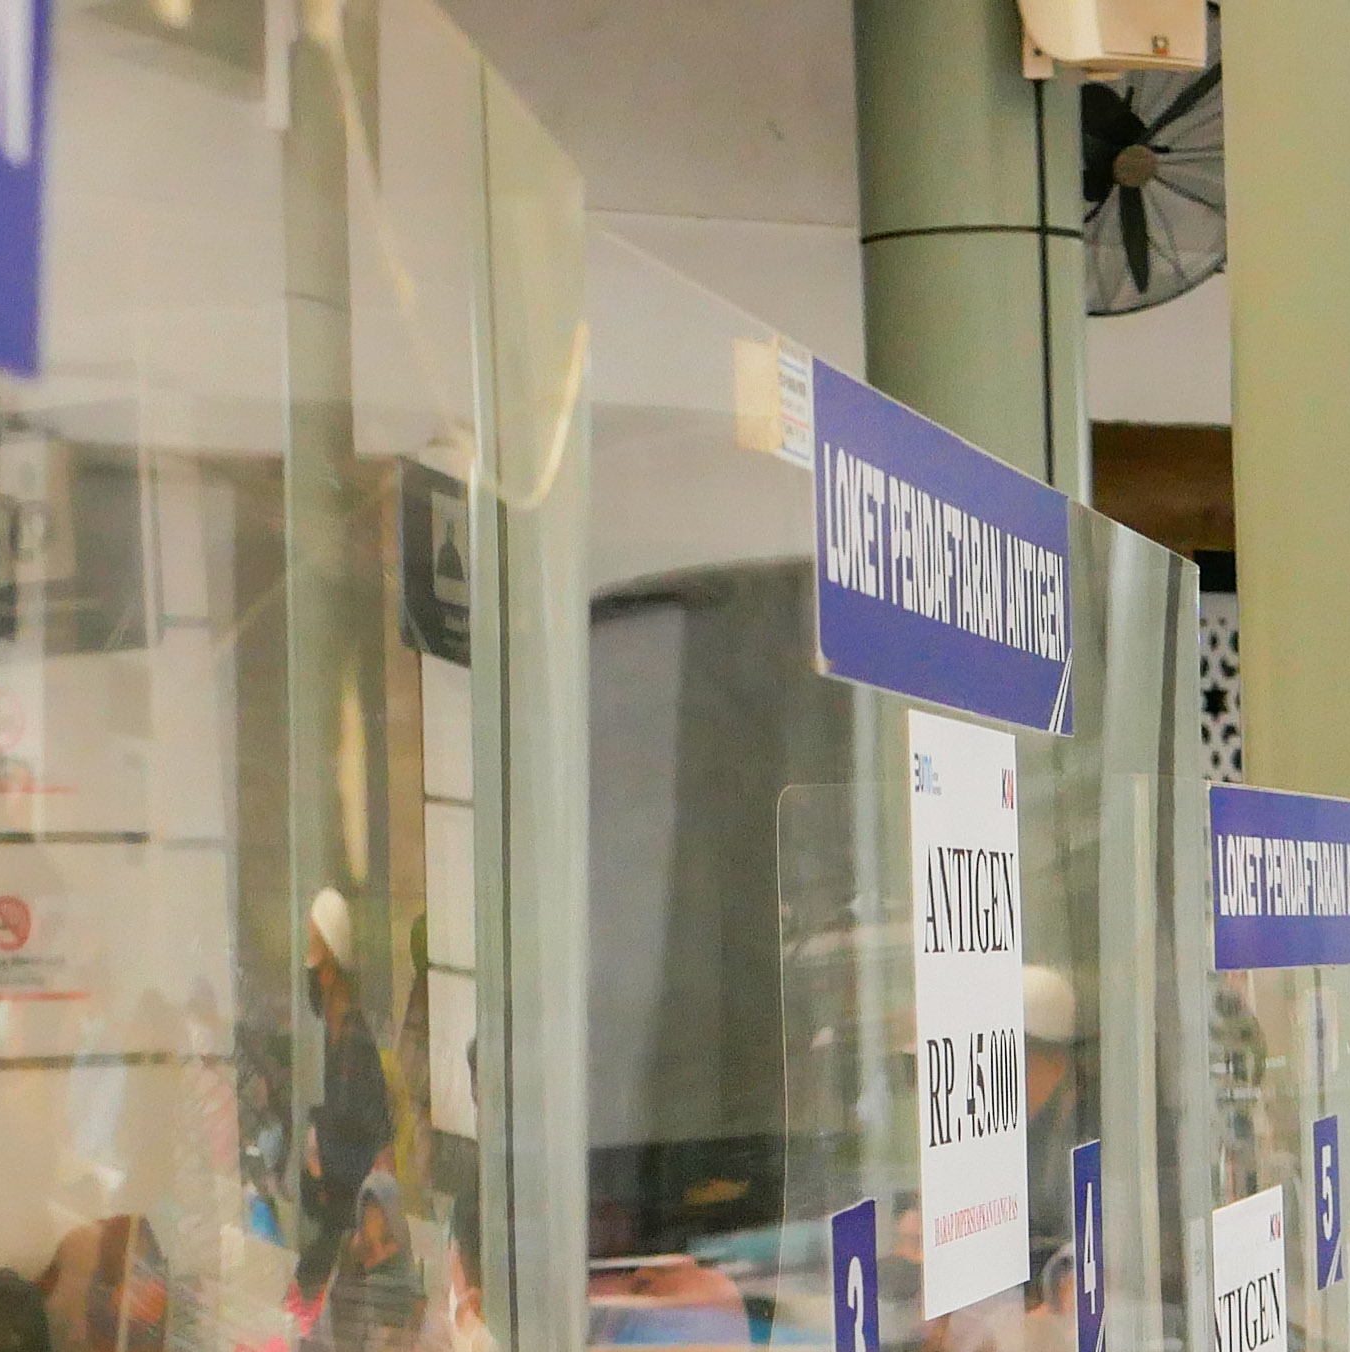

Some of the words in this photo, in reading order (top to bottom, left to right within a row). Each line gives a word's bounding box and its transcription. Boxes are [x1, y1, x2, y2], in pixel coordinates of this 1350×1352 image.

[823, 442, 885, 601] LOKET
[889, 475, 1003, 644] PENDAFTARAN
[1006, 533, 1066, 663] ANTIGEN
[924, 845, 1016, 954] ANTIGEN
[1217, 834, 1262, 917] LOKET
[1265, 837, 1346, 916] PENDAFTARAN
[927, 1037, 963, 1147] RP.
[966, 1027, 1019, 1138] 45.000
[1085, 1182, 1097, 1315] 4
[1321, 1145, 1333, 1240] 5
